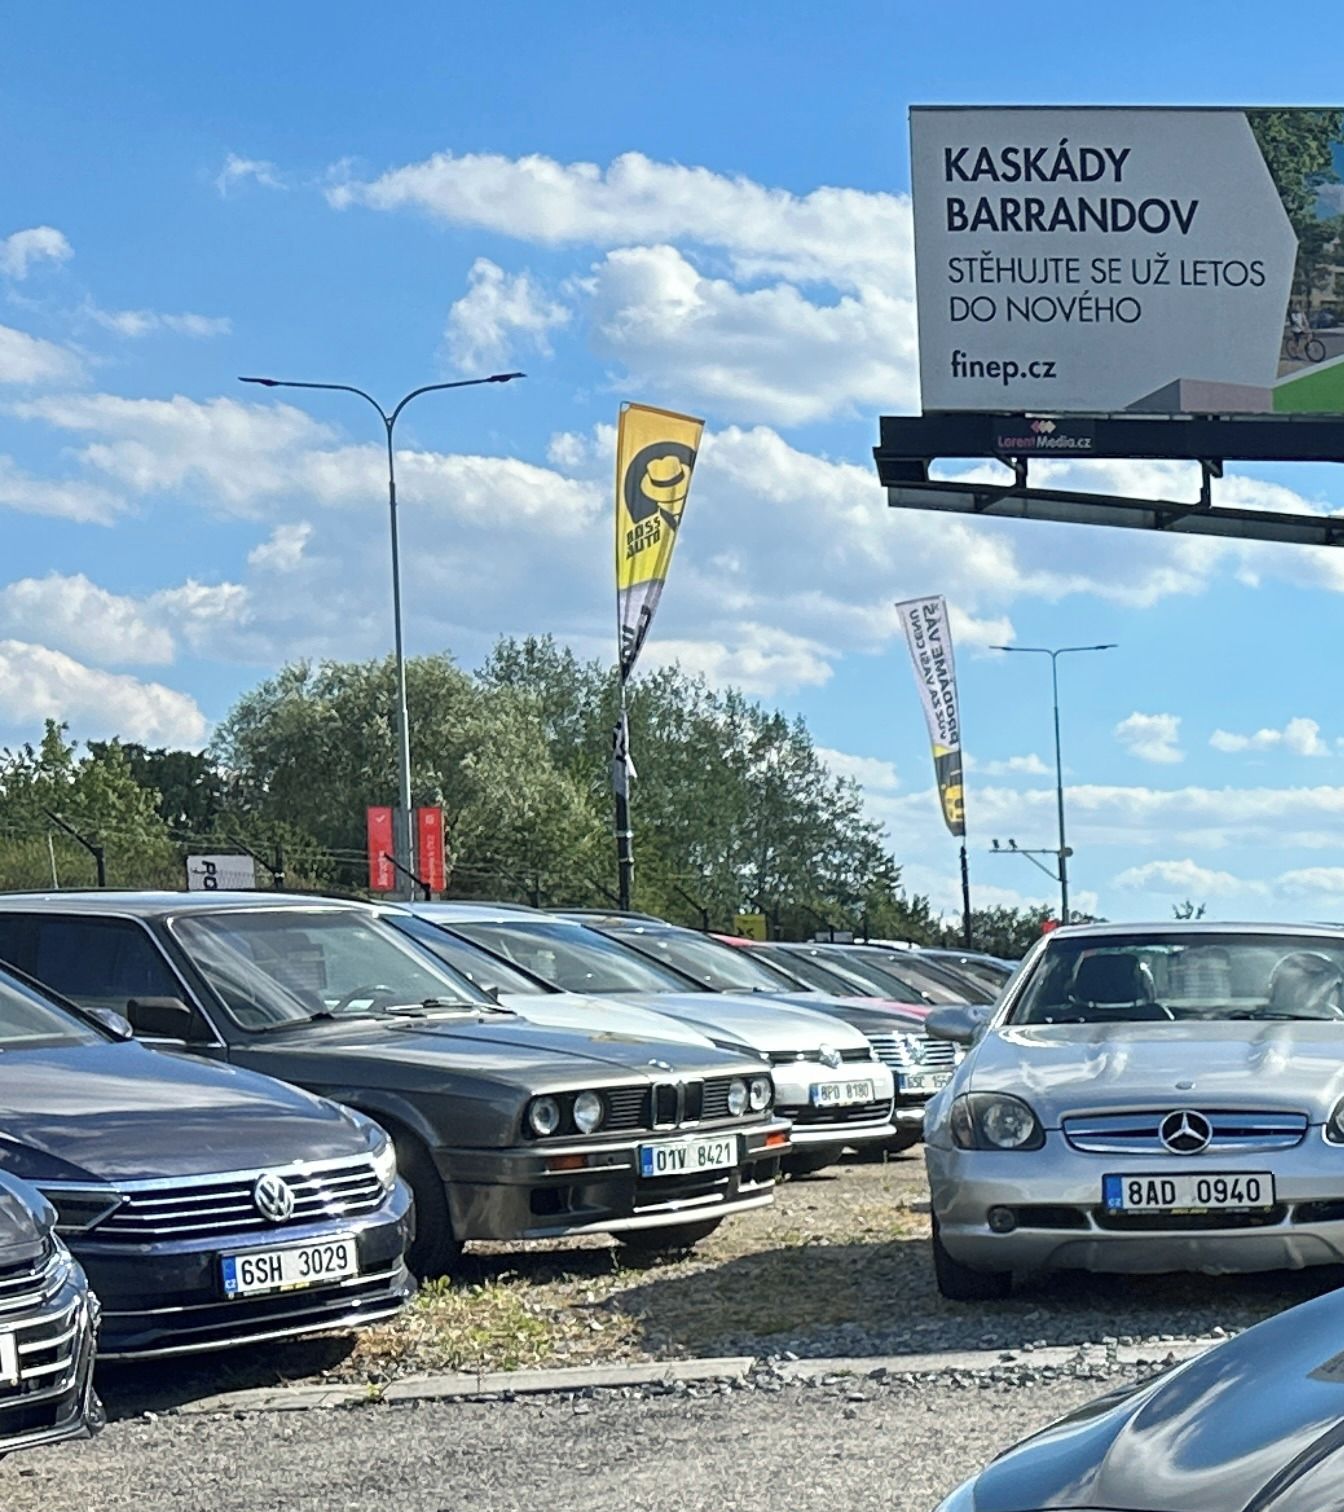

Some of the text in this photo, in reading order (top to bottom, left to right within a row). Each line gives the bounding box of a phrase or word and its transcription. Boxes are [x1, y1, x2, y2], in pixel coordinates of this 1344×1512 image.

[944, 137, 1132, 183] KASKÁDY
[946, 196, 1200, 235] BARRANDOV
[947, 249, 1266, 287] STĚHUJTE SE UŽ LETOS
[949, 289, 1142, 324] DO NOVÉHO
[951, 350, 1057, 386] finep.cz
[626, 515, 661, 546] BOSS
[626, 529, 661, 561] AUTO
[697, 1142, 731, 1166] 8421
[1128, 1177, 1261, 1206] 8AD 0940
[241, 1244, 348, 1286] 6SH 3029
